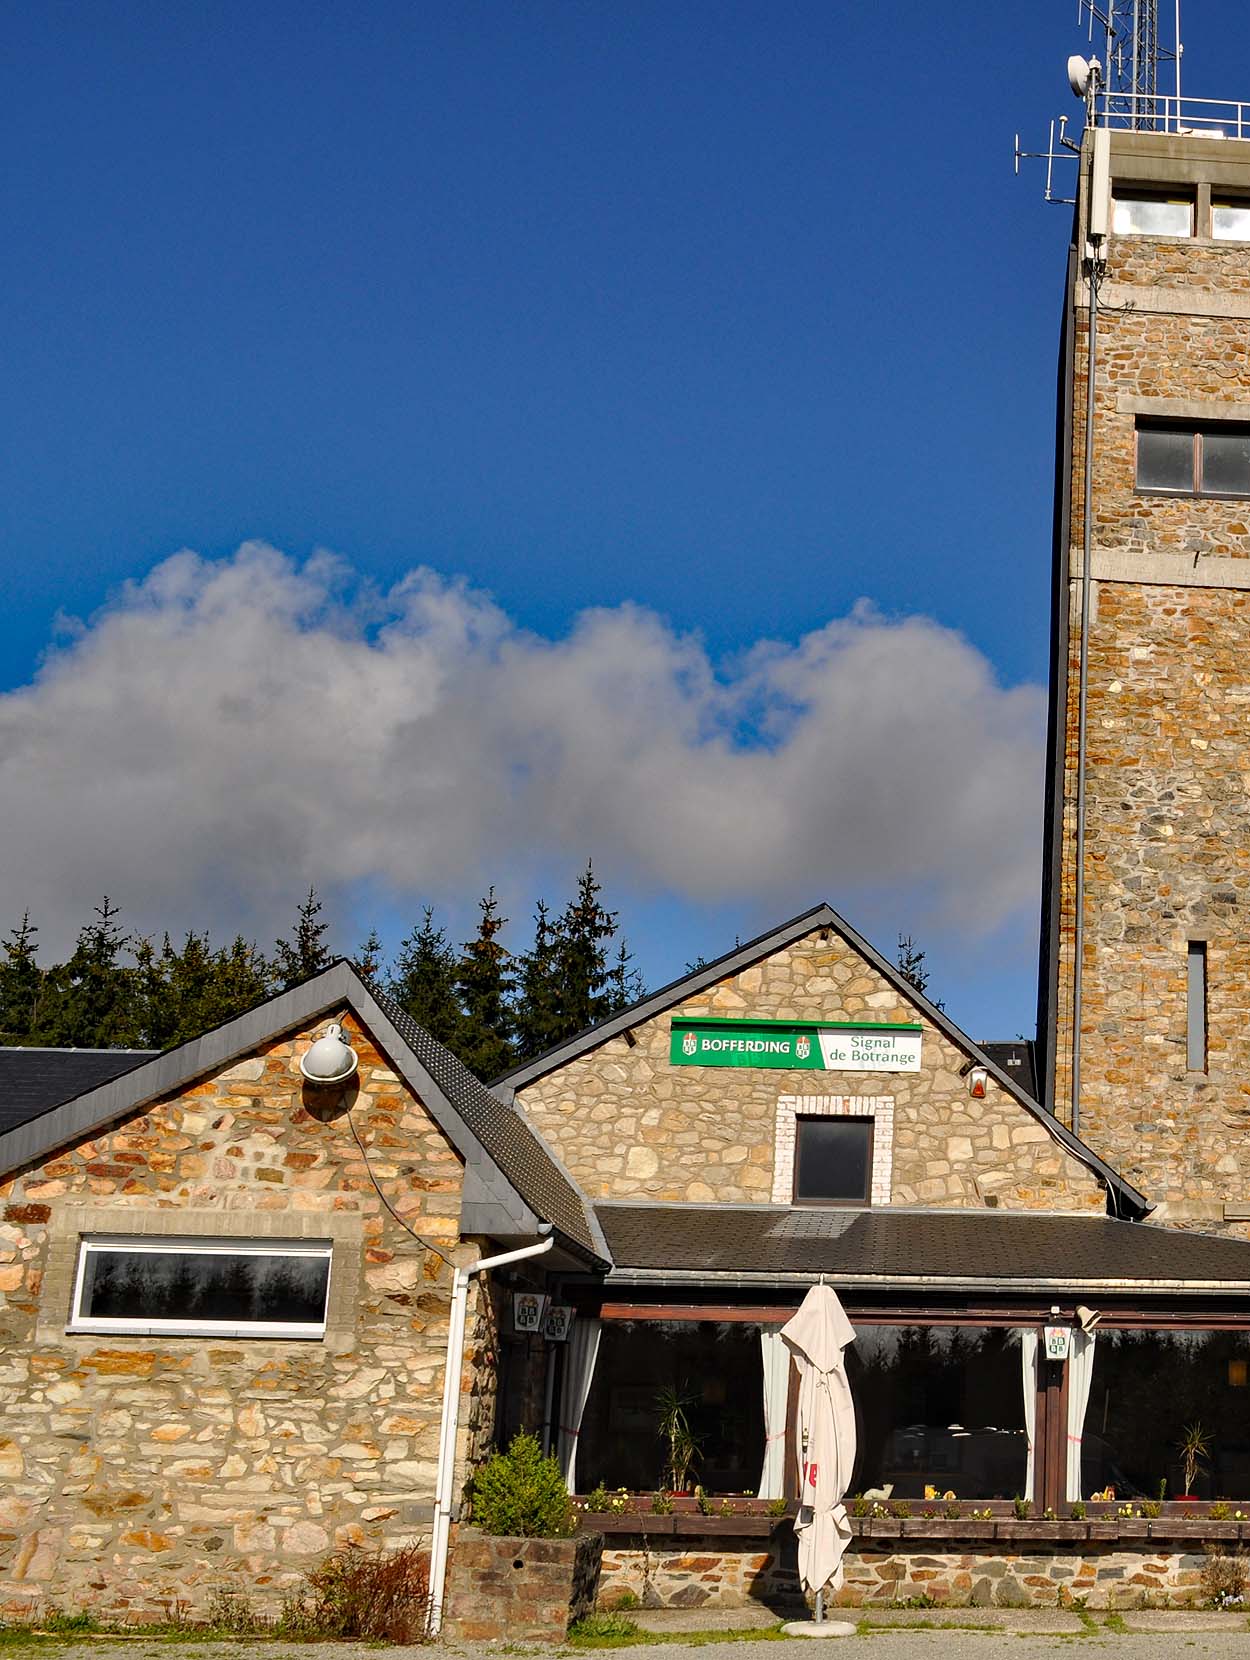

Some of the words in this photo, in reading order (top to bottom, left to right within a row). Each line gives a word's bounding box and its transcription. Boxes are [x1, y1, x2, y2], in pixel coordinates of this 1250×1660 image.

[701, 1039, 791, 1054] BOFFERDING
[850, 1036, 896, 1051] Signal
[829, 1049, 847, 1061] de
[851, 1050, 916, 1065] Botrange
